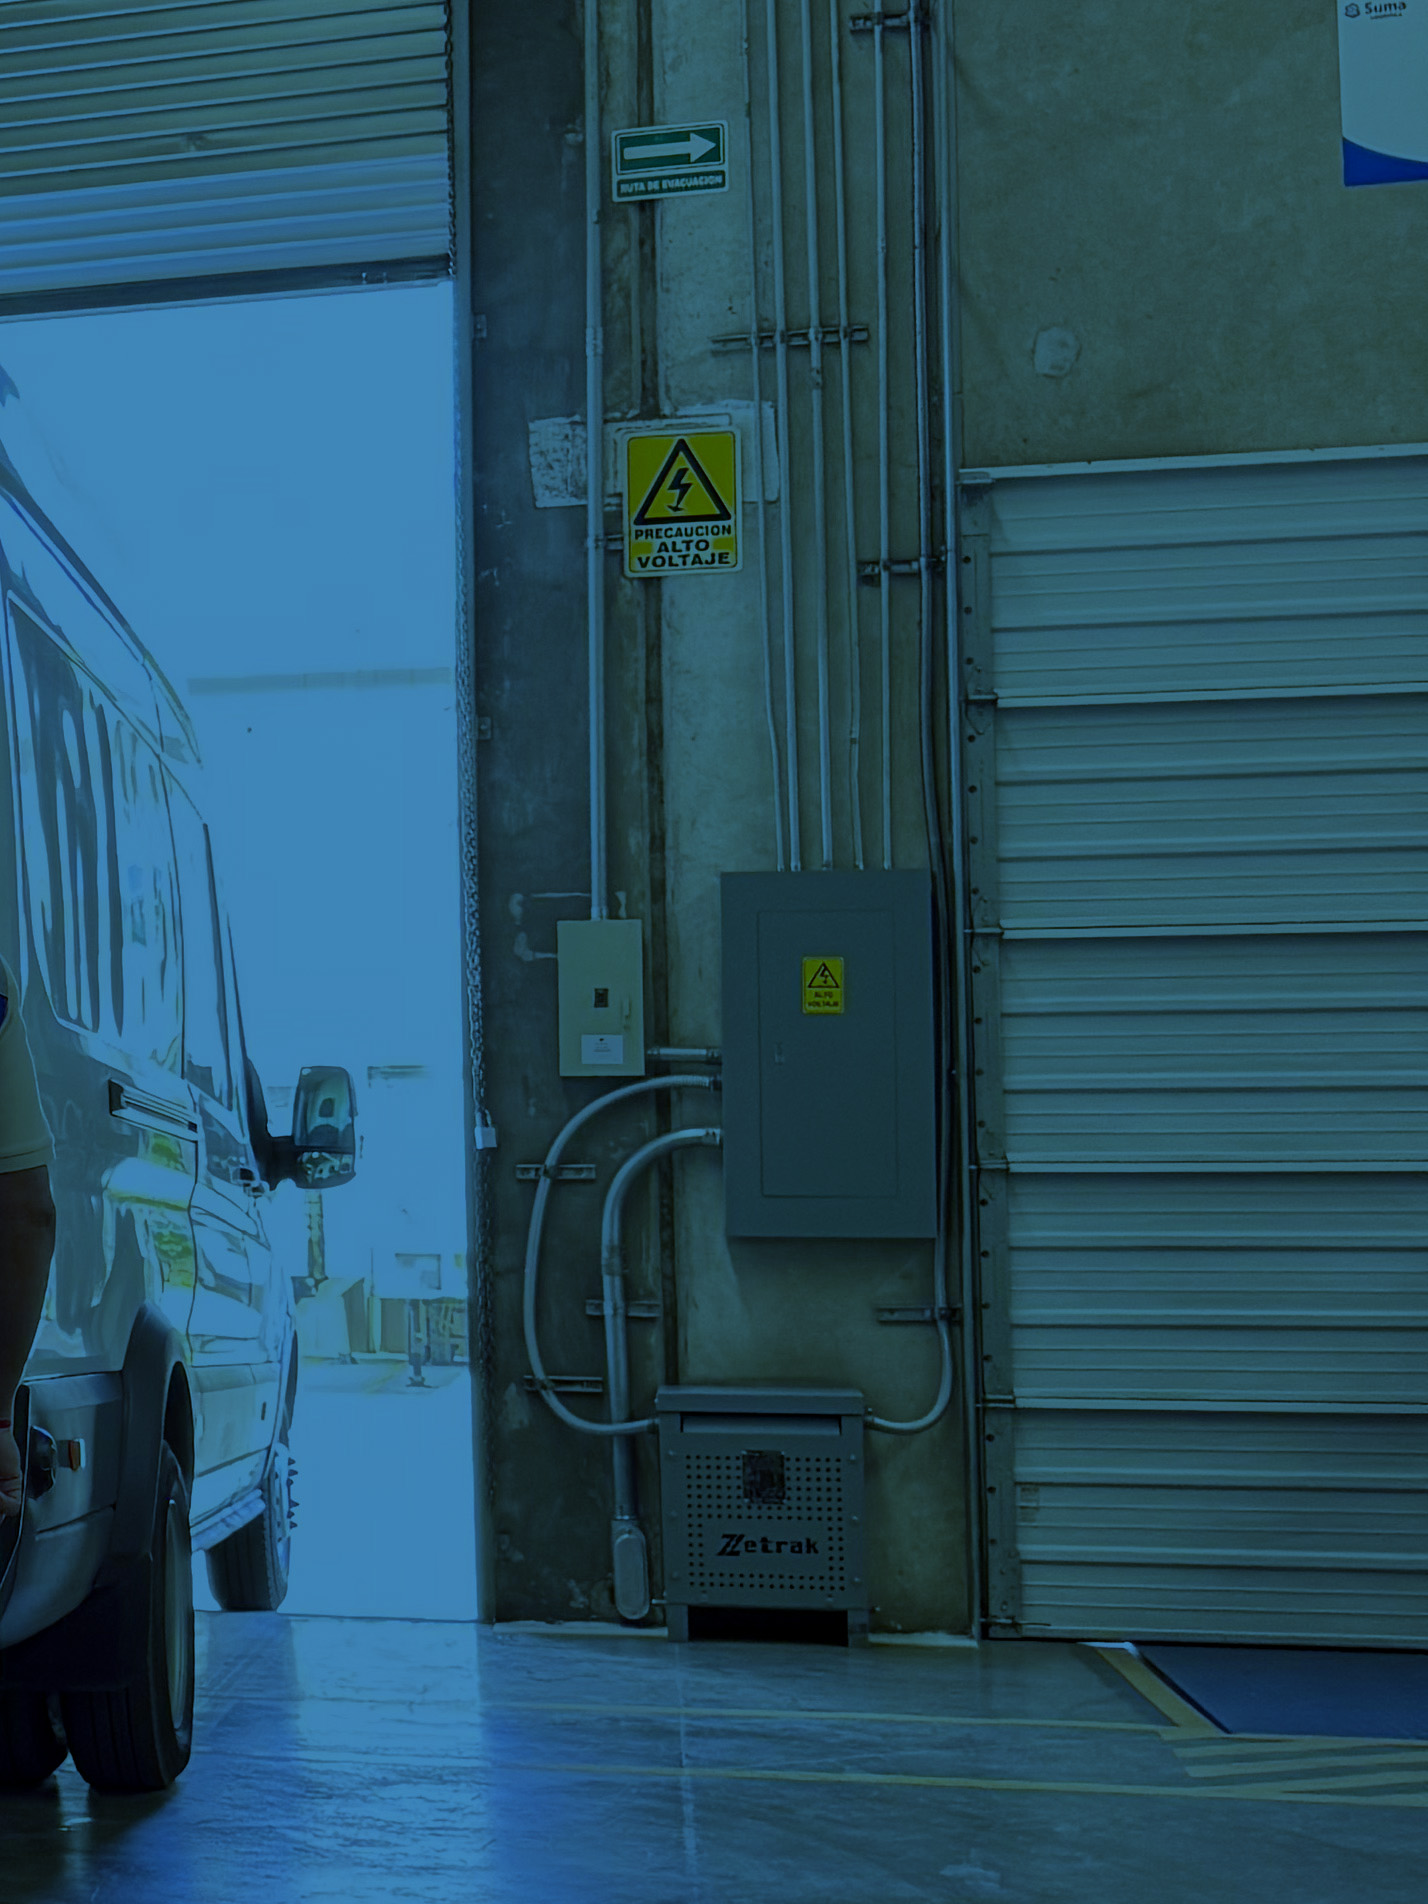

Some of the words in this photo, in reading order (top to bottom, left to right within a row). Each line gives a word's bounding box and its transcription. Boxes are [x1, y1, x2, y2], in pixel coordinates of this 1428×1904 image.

[635, 525, 731, 540] PRECAUCION
[657, 539, 710, 553] ALTO
[637, 552, 731, 568] VOLTAJE
[717, 1534, 819, 1556] Zetrak
